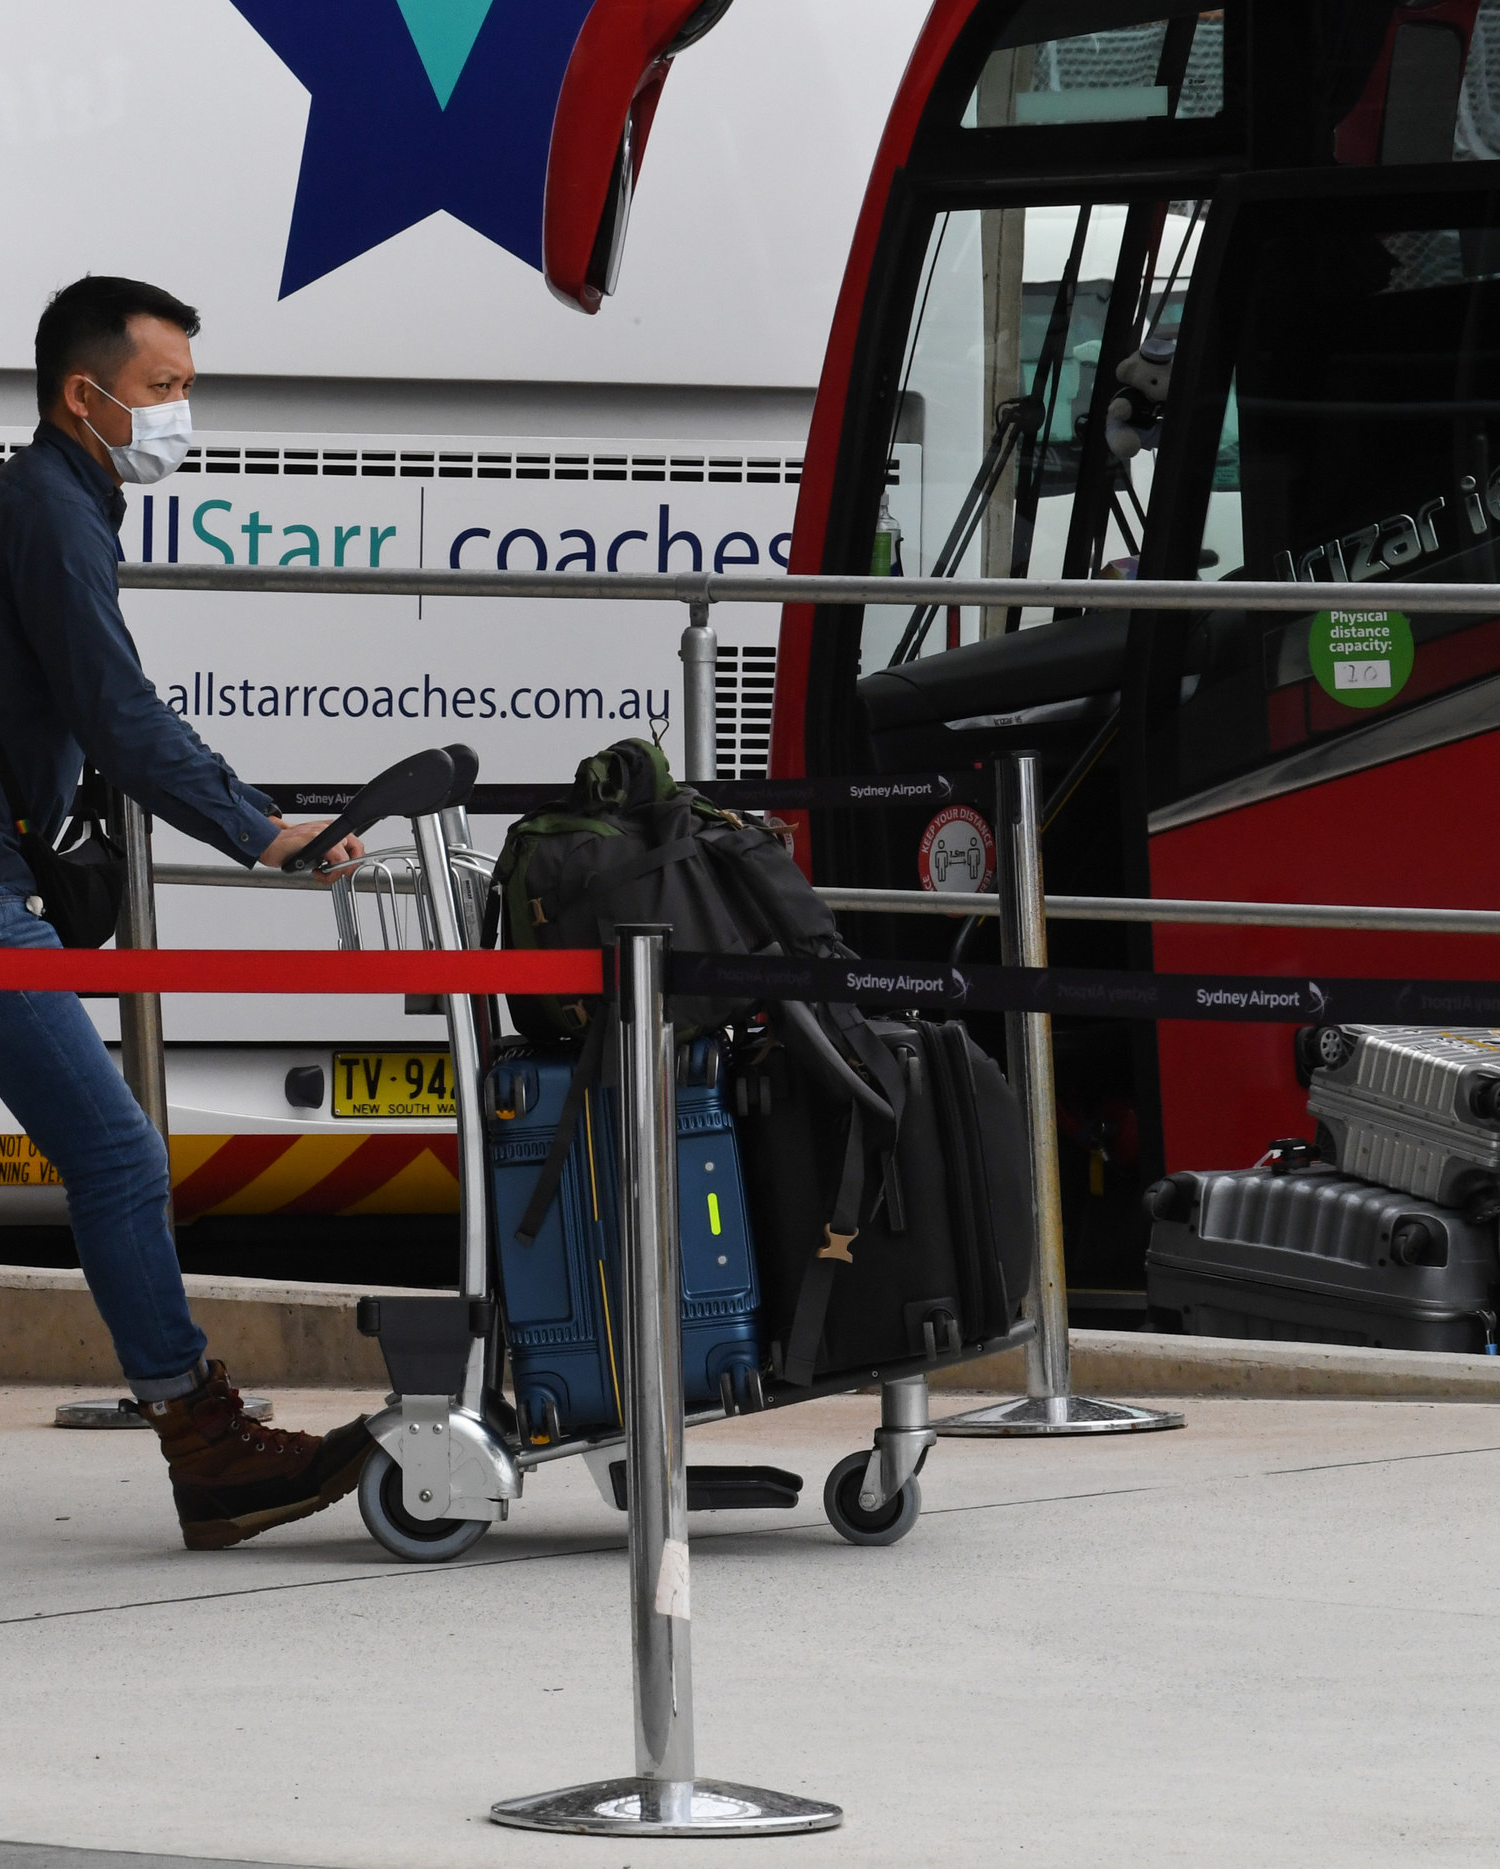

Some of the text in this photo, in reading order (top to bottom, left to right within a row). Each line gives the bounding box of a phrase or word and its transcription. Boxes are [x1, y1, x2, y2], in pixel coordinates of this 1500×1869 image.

[118, 495, 397, 567] llStarr
[1330, 611, 1388, 626] Physical
[1330, 626, 1390, 639] distance
[1329, 639, 1393, 654] capacity:
[167, 672, 670, 720] allstarrcoaches.com.au
[295, 792, 335, 806] Sydney
[850, 783, 932, 799] Sydney Airport
[920, 808, 993, 854] KEEP YOUR DISTANCE
[846, 972, 944, 994] Sydney Airport
[1196, 988, 1300, 1009] Sydney Airport
[405, 1058, 455, 1100] 94
[353, 1103, 381, 1114] NEW
[388, 1103, 430, 1114] SOUTH
